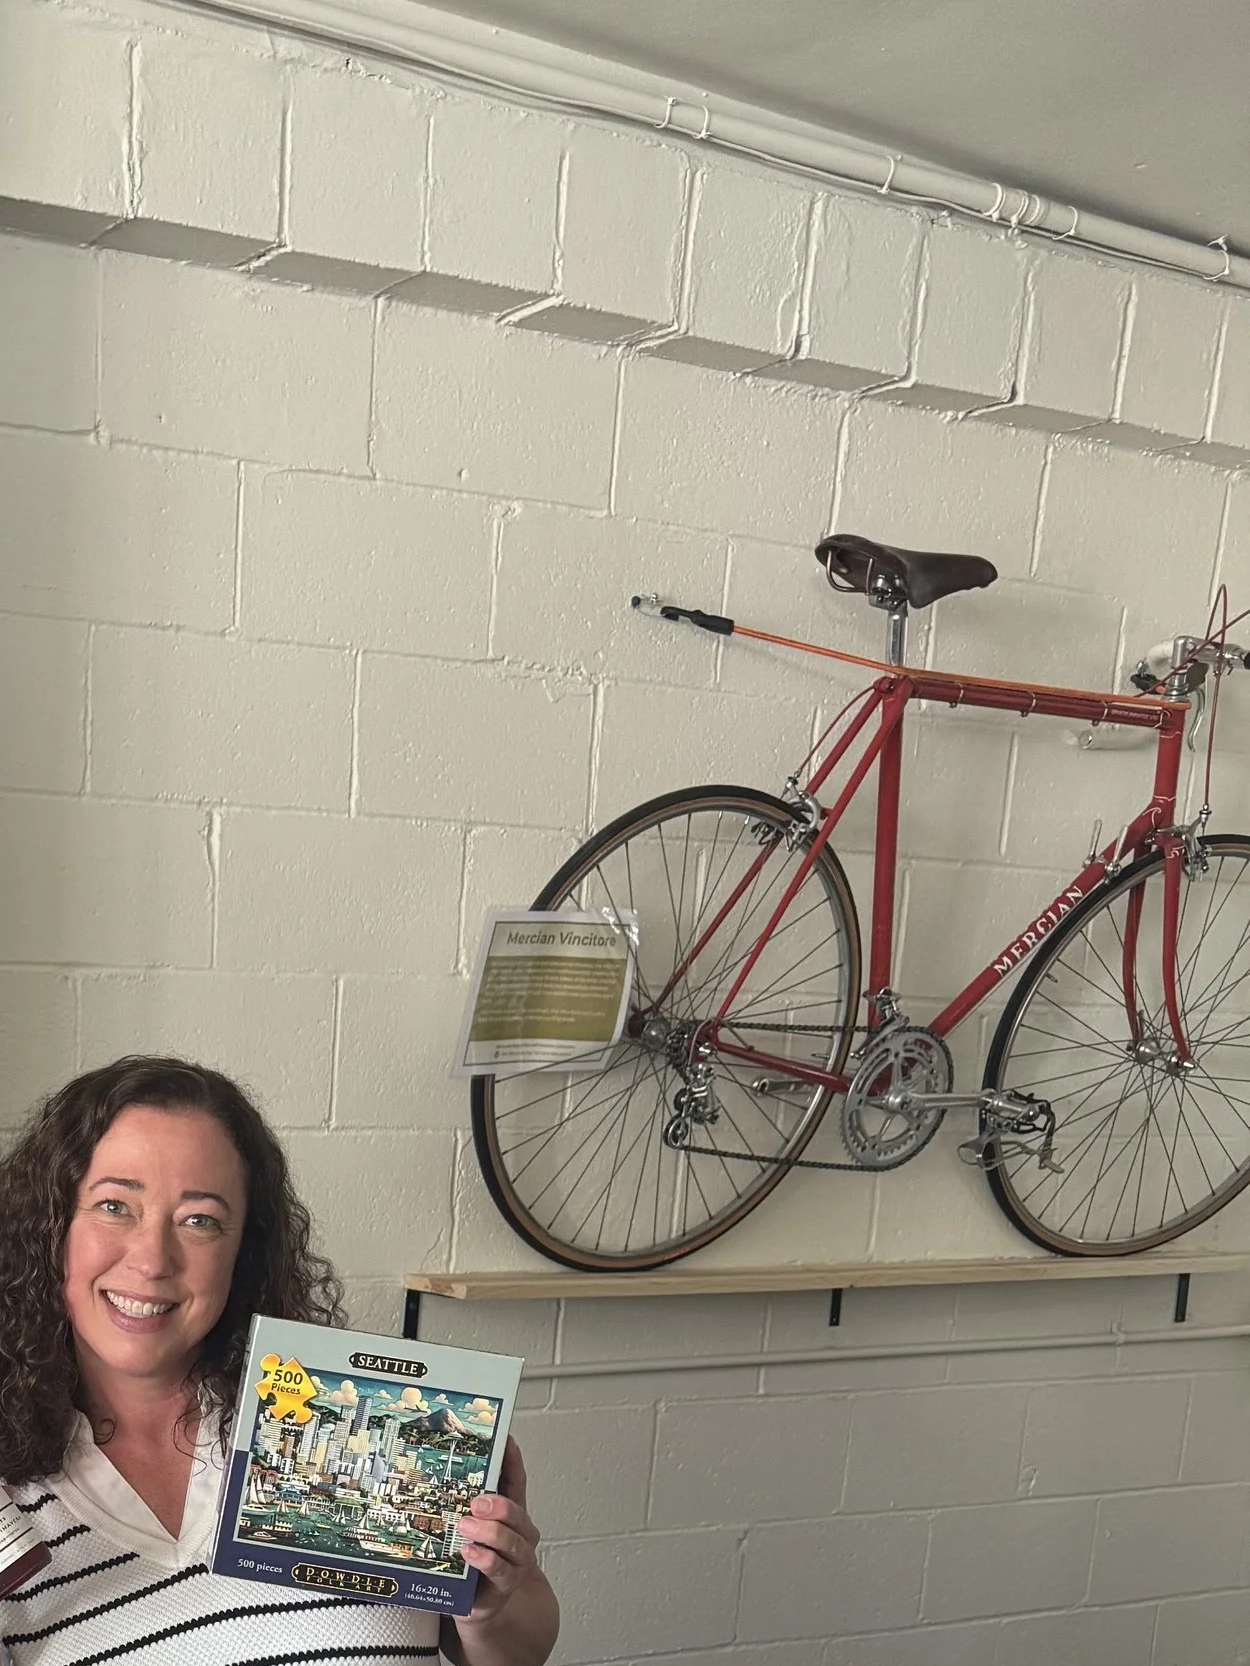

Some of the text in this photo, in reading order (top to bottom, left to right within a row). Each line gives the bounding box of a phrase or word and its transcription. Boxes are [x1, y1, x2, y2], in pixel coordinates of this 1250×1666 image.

[506, 930, 617, 948] Mercian Vincitore
[993, 885, 1083, 978] MERCIAN
[357, 1354, 419, 1376] SEATTLE
[272, 1368, 303, 1386] 500
[270, 1382, 301, 1396] Pieces
[237, 1557, 283, 1574] 500 pieces
